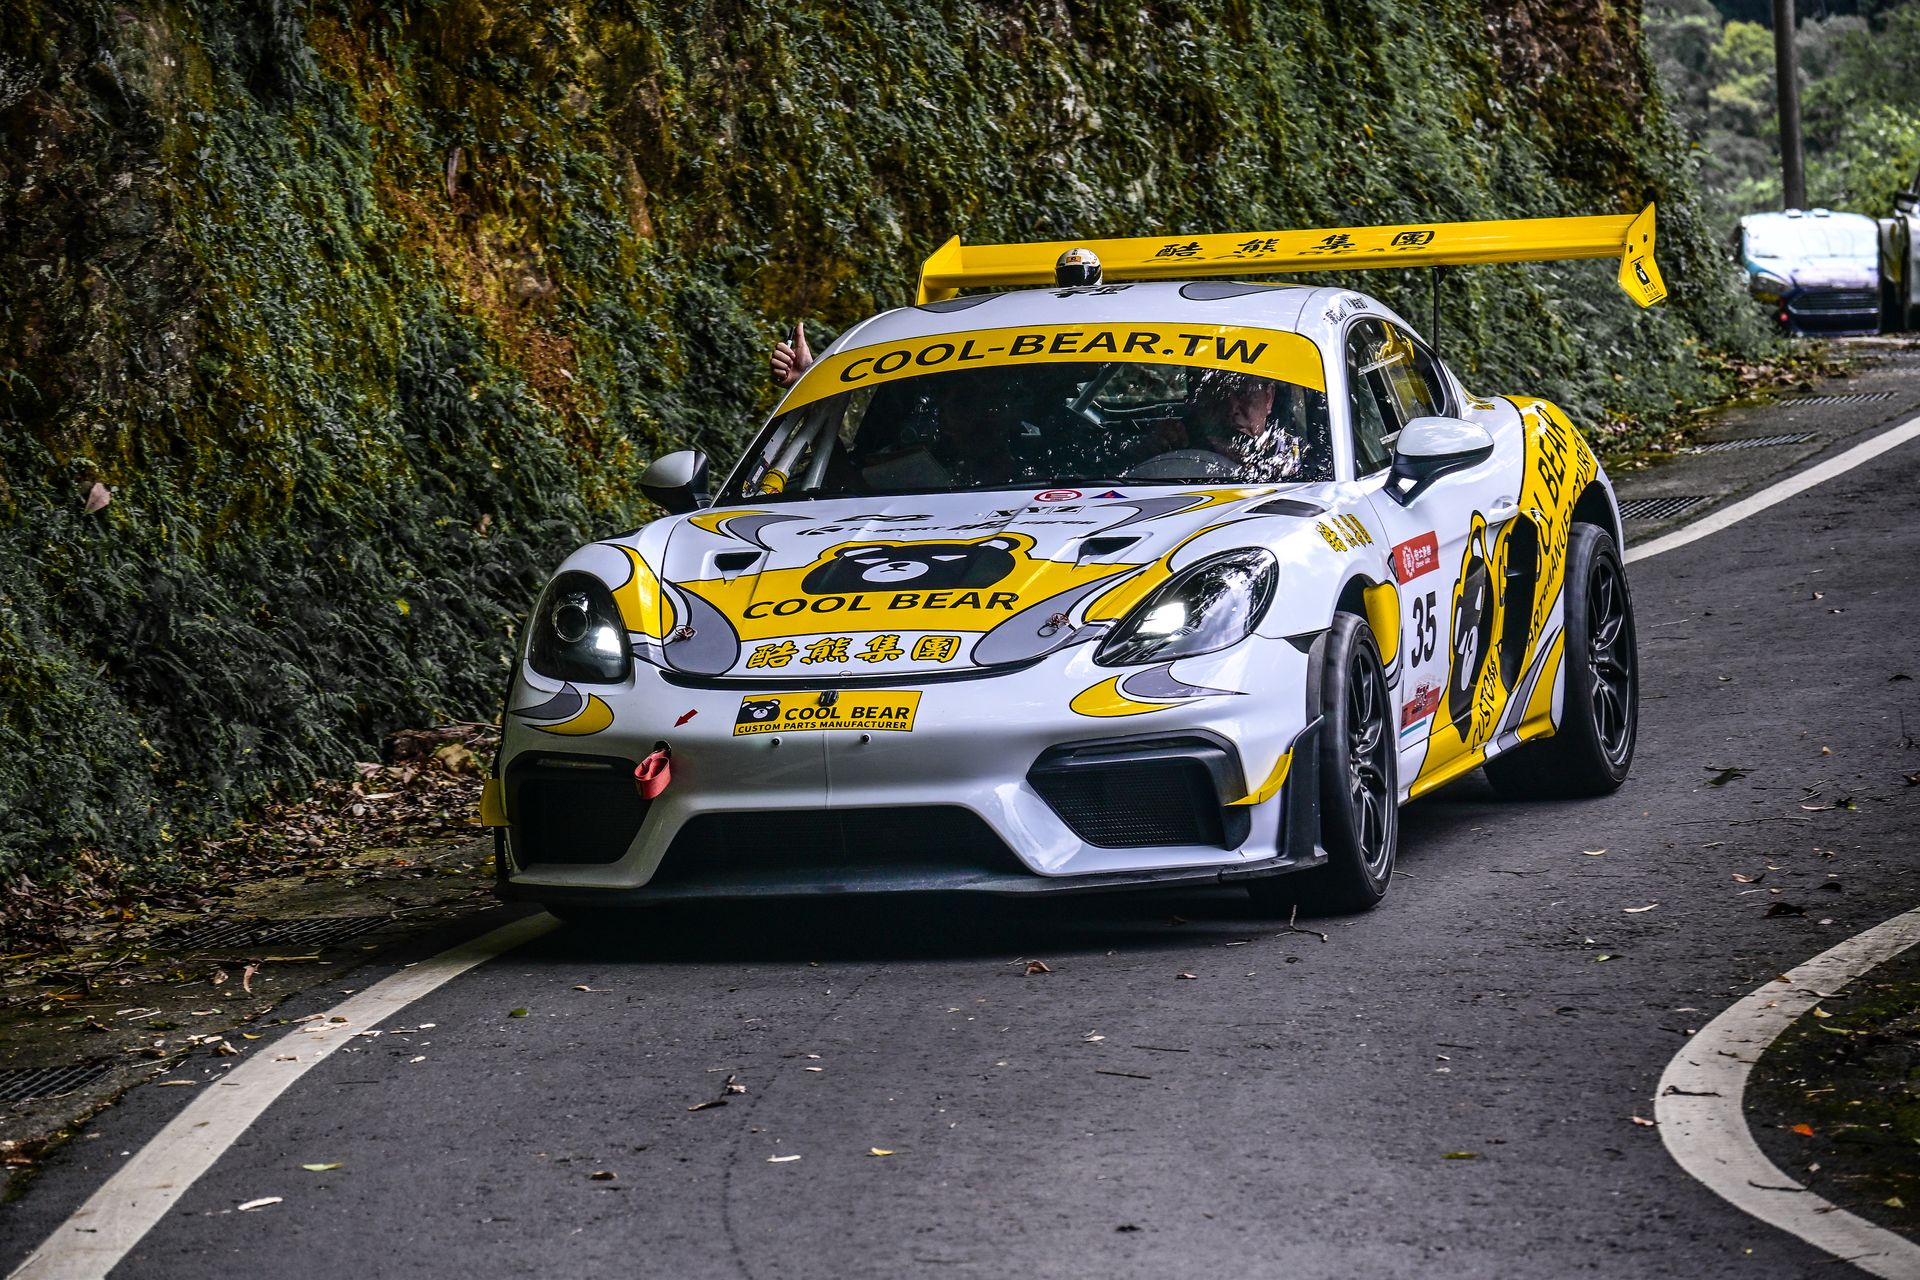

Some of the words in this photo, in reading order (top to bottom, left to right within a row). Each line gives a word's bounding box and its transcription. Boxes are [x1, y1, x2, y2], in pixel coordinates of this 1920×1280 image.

[1155, 230, 1435, 257] 酷熊集團
[840, 331, 1268, 383] COOL-BEAR.TW
[1536, 405, 1567, 509] BEAR
[742, 594, 873, 619] COOL
[887, 591, 1019, 611] BEAR
[1411, 590, 1437, 668] 35
[746, 634, 962, 669] 酷熊集團
[784, 706, 841, 721] COOL
[850, 706, 910, 720] BEAR
[1471, 656, 1498, 754] CUSTOM
[738, 723, 781, 734] CUSTOM
[783, 721, 816, 730] PARTS
[819, 720, 907, 729] MANUFACTURER
